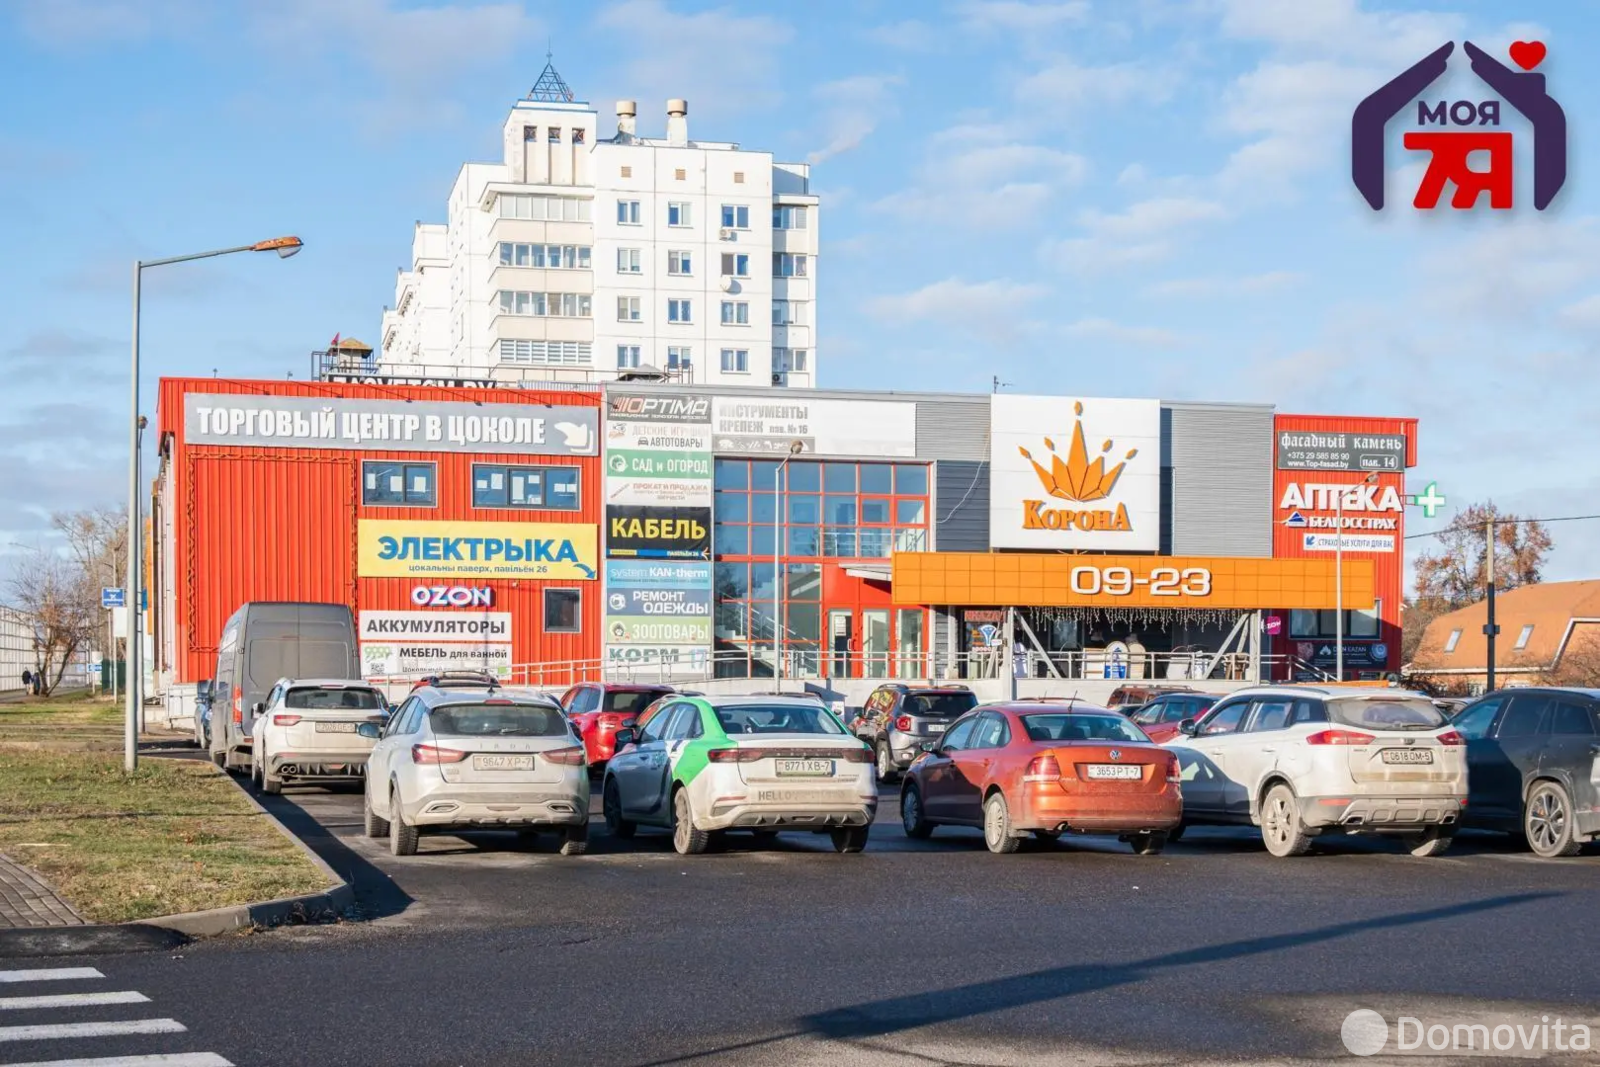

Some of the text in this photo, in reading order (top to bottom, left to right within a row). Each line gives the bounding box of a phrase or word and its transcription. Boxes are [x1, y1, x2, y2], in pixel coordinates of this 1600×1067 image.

[627, 397, 708, 415] OPTIMA
[719, 404, 808, 420] ИНСТРУМЕНТЫ
[196, 406, 546, 446] ТОРГОВЫЙ ЦЕНТР В ЦОКОЛЕ
[632, 425, 668, 436] ДЕТСКИЕ
[719, 420, 763, 433] КРЕПЕЖ
[787, 425, 797, 433] №
[798, 424, 808, 434] 16
[650, 437, 703, 448] АВТОТОВАРЫ
[1281, 432, 1402, 450] фасадный камень
[1287, 451, 1305, 459] +375
[1305, 451, 1315, 460] 29
[1384, 457, 1395, 467] 14
[632, 458, 708, 474] САД и ОГОРОД
[1280, 482, 1403, 512] АПТЕКА
[612, 518, 706, 539] КАБЕЛЬ
[377, 536, 579, 562] ЭЛЕКТРЫКА
[1318, 538, 1349, 547] СТРАХОЫЕ
[1350, 539, 1370, 547] УСЛУГИ
[1371, 539, 1382, 548] ДЛЯ
[409, 564, 455, 573] цокальны
[457, 565, 492, 573] паверх,
[494, 565, 535, 573] павільён
[610, 567, 708, 579] system KAN-therm
[1070, 566, 1211, 596] 09-23
[411, 586, 492, 606] OZON
[633, 591, 685, 602] РЕМОНТ
[643, 602, 708, 614] ОДЕЖДЫ
[366, 619, 505, 634] АККУМУЛЯТОРЫ
[632, 624, 709, 639] ЗООТОВАРЫ
[399, 648, 447, 658] МЕБЕЛЬ
[449, 651, 468, 659] для
[470, 649, 507, 658] ванной
[609, 648, 679, 662] КОРМ
[784, 761, 805, 771] 8771
[758, 790, 791, 801] HELLO
